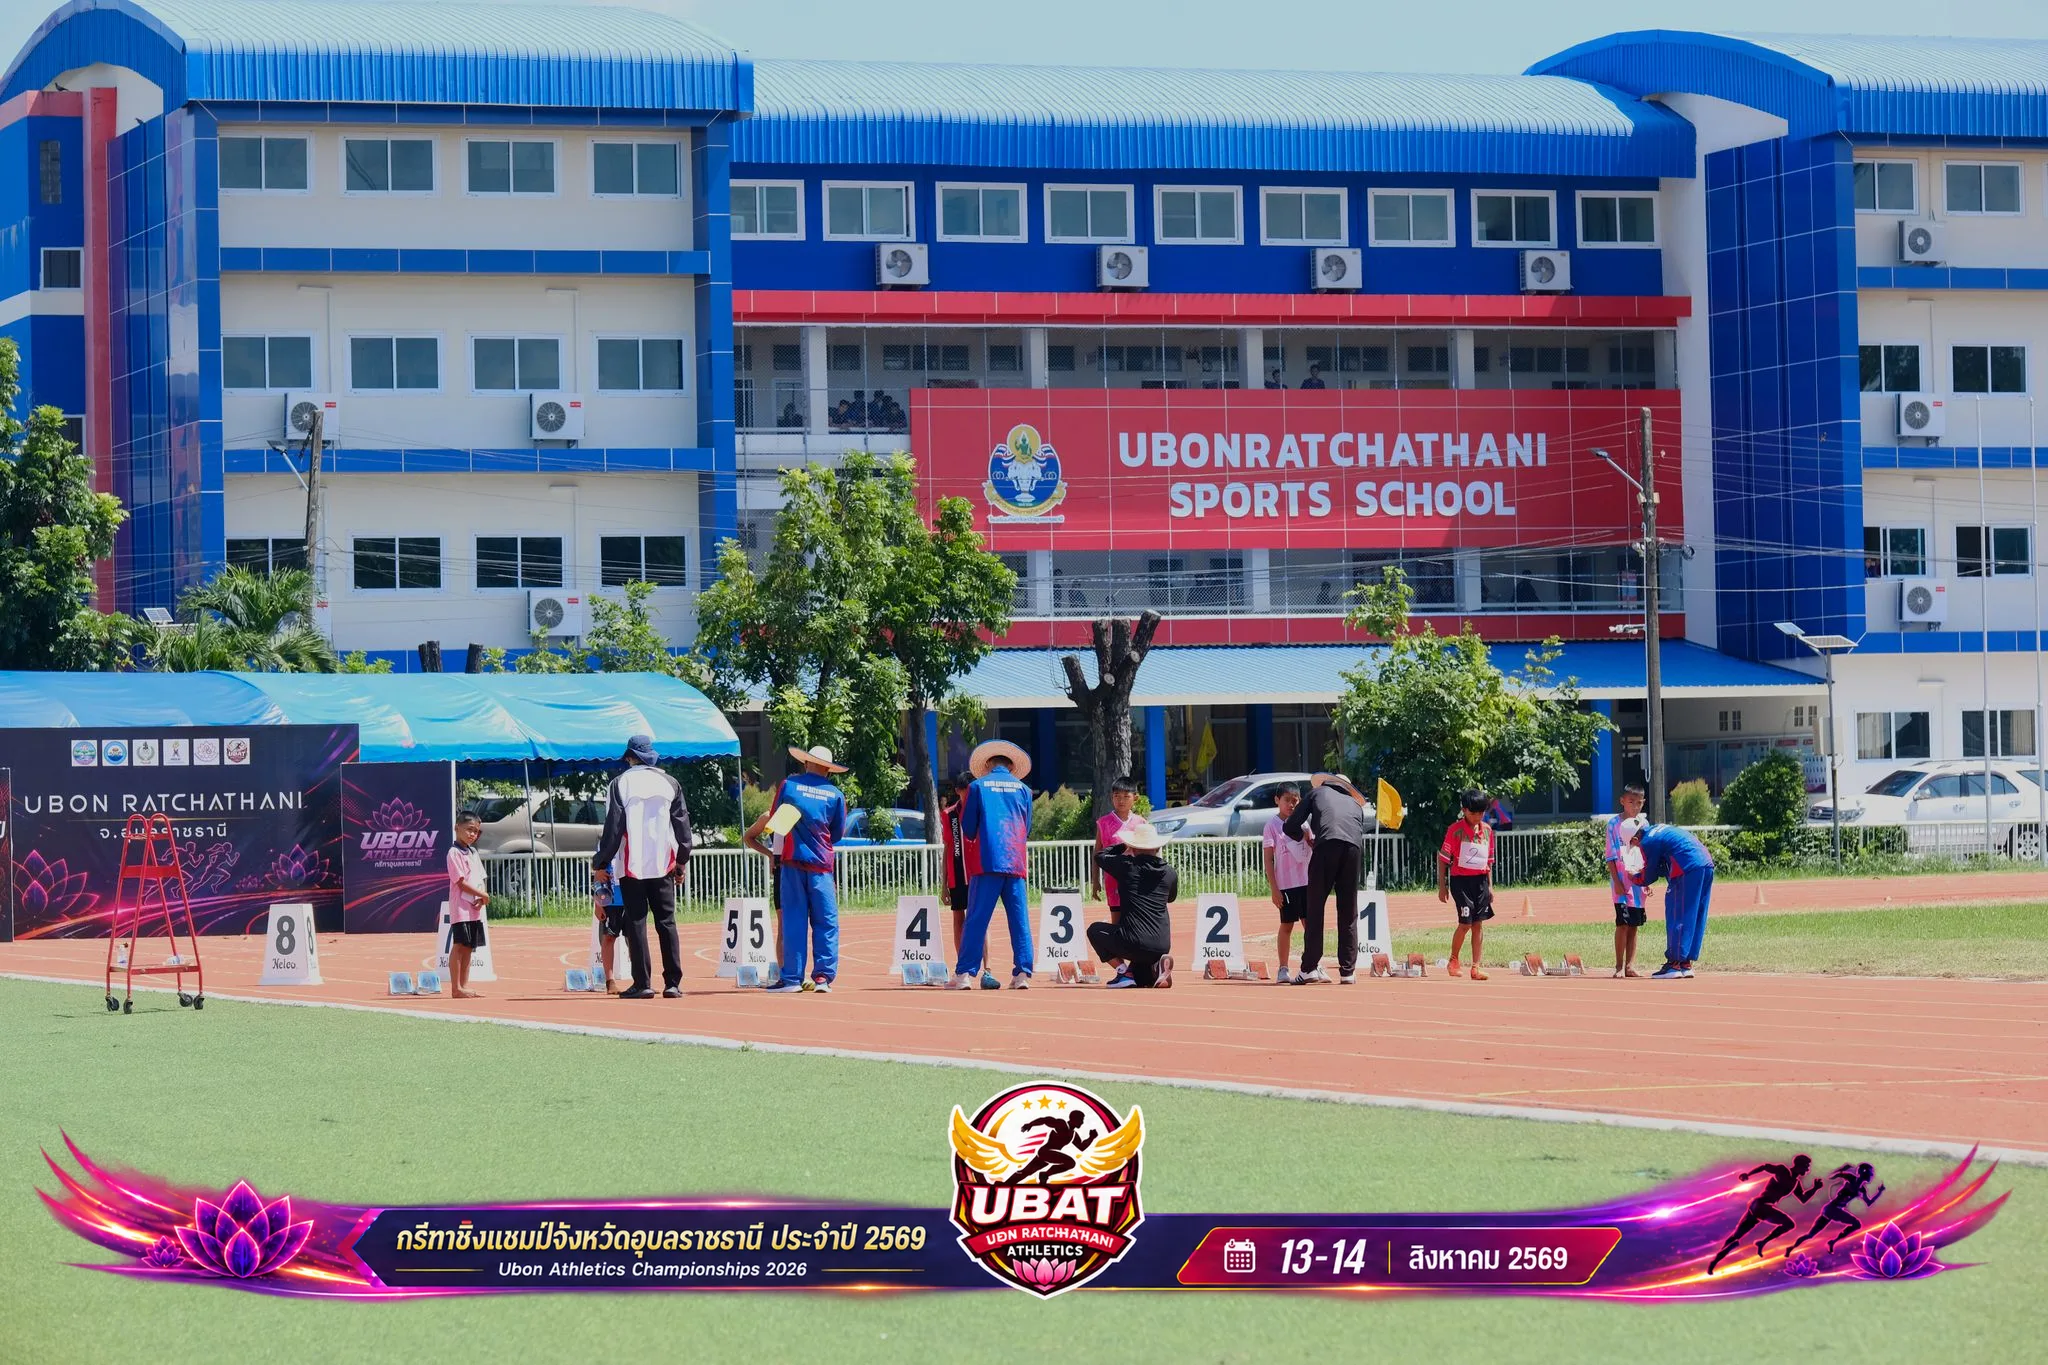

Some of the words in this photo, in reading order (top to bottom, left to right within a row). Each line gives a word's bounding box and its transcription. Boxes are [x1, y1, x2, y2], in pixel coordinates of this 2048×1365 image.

[1118, 432, 1547, 468] UBONRATCHATHANI
[1170, 481, 1331, 519] SPORTS
[1354, 480, 1517, 518] SCHOOL
[24, 794, 108, 814] UBON
[122, 791, 303, 812] RATCHATHANI
[360, 830, 440, 850] UBON
[361, 848, 436, 860] ATHLETICS
[1465, 847, 1478, 865] 2
[275, 915, 296, 956] 8
[726, 909, 739, 950] 5
[749, 909, 764, 949] 5
[905, 907, 931, 947] 4
[1049, 905, 1075, 944] 3
[1205, 905, 1230, 943] 2
[1359, 901, 1377, 941] 1
[901, 949, 932, 961] Nelco
[1203, 946, 1231, 958] Nelco
